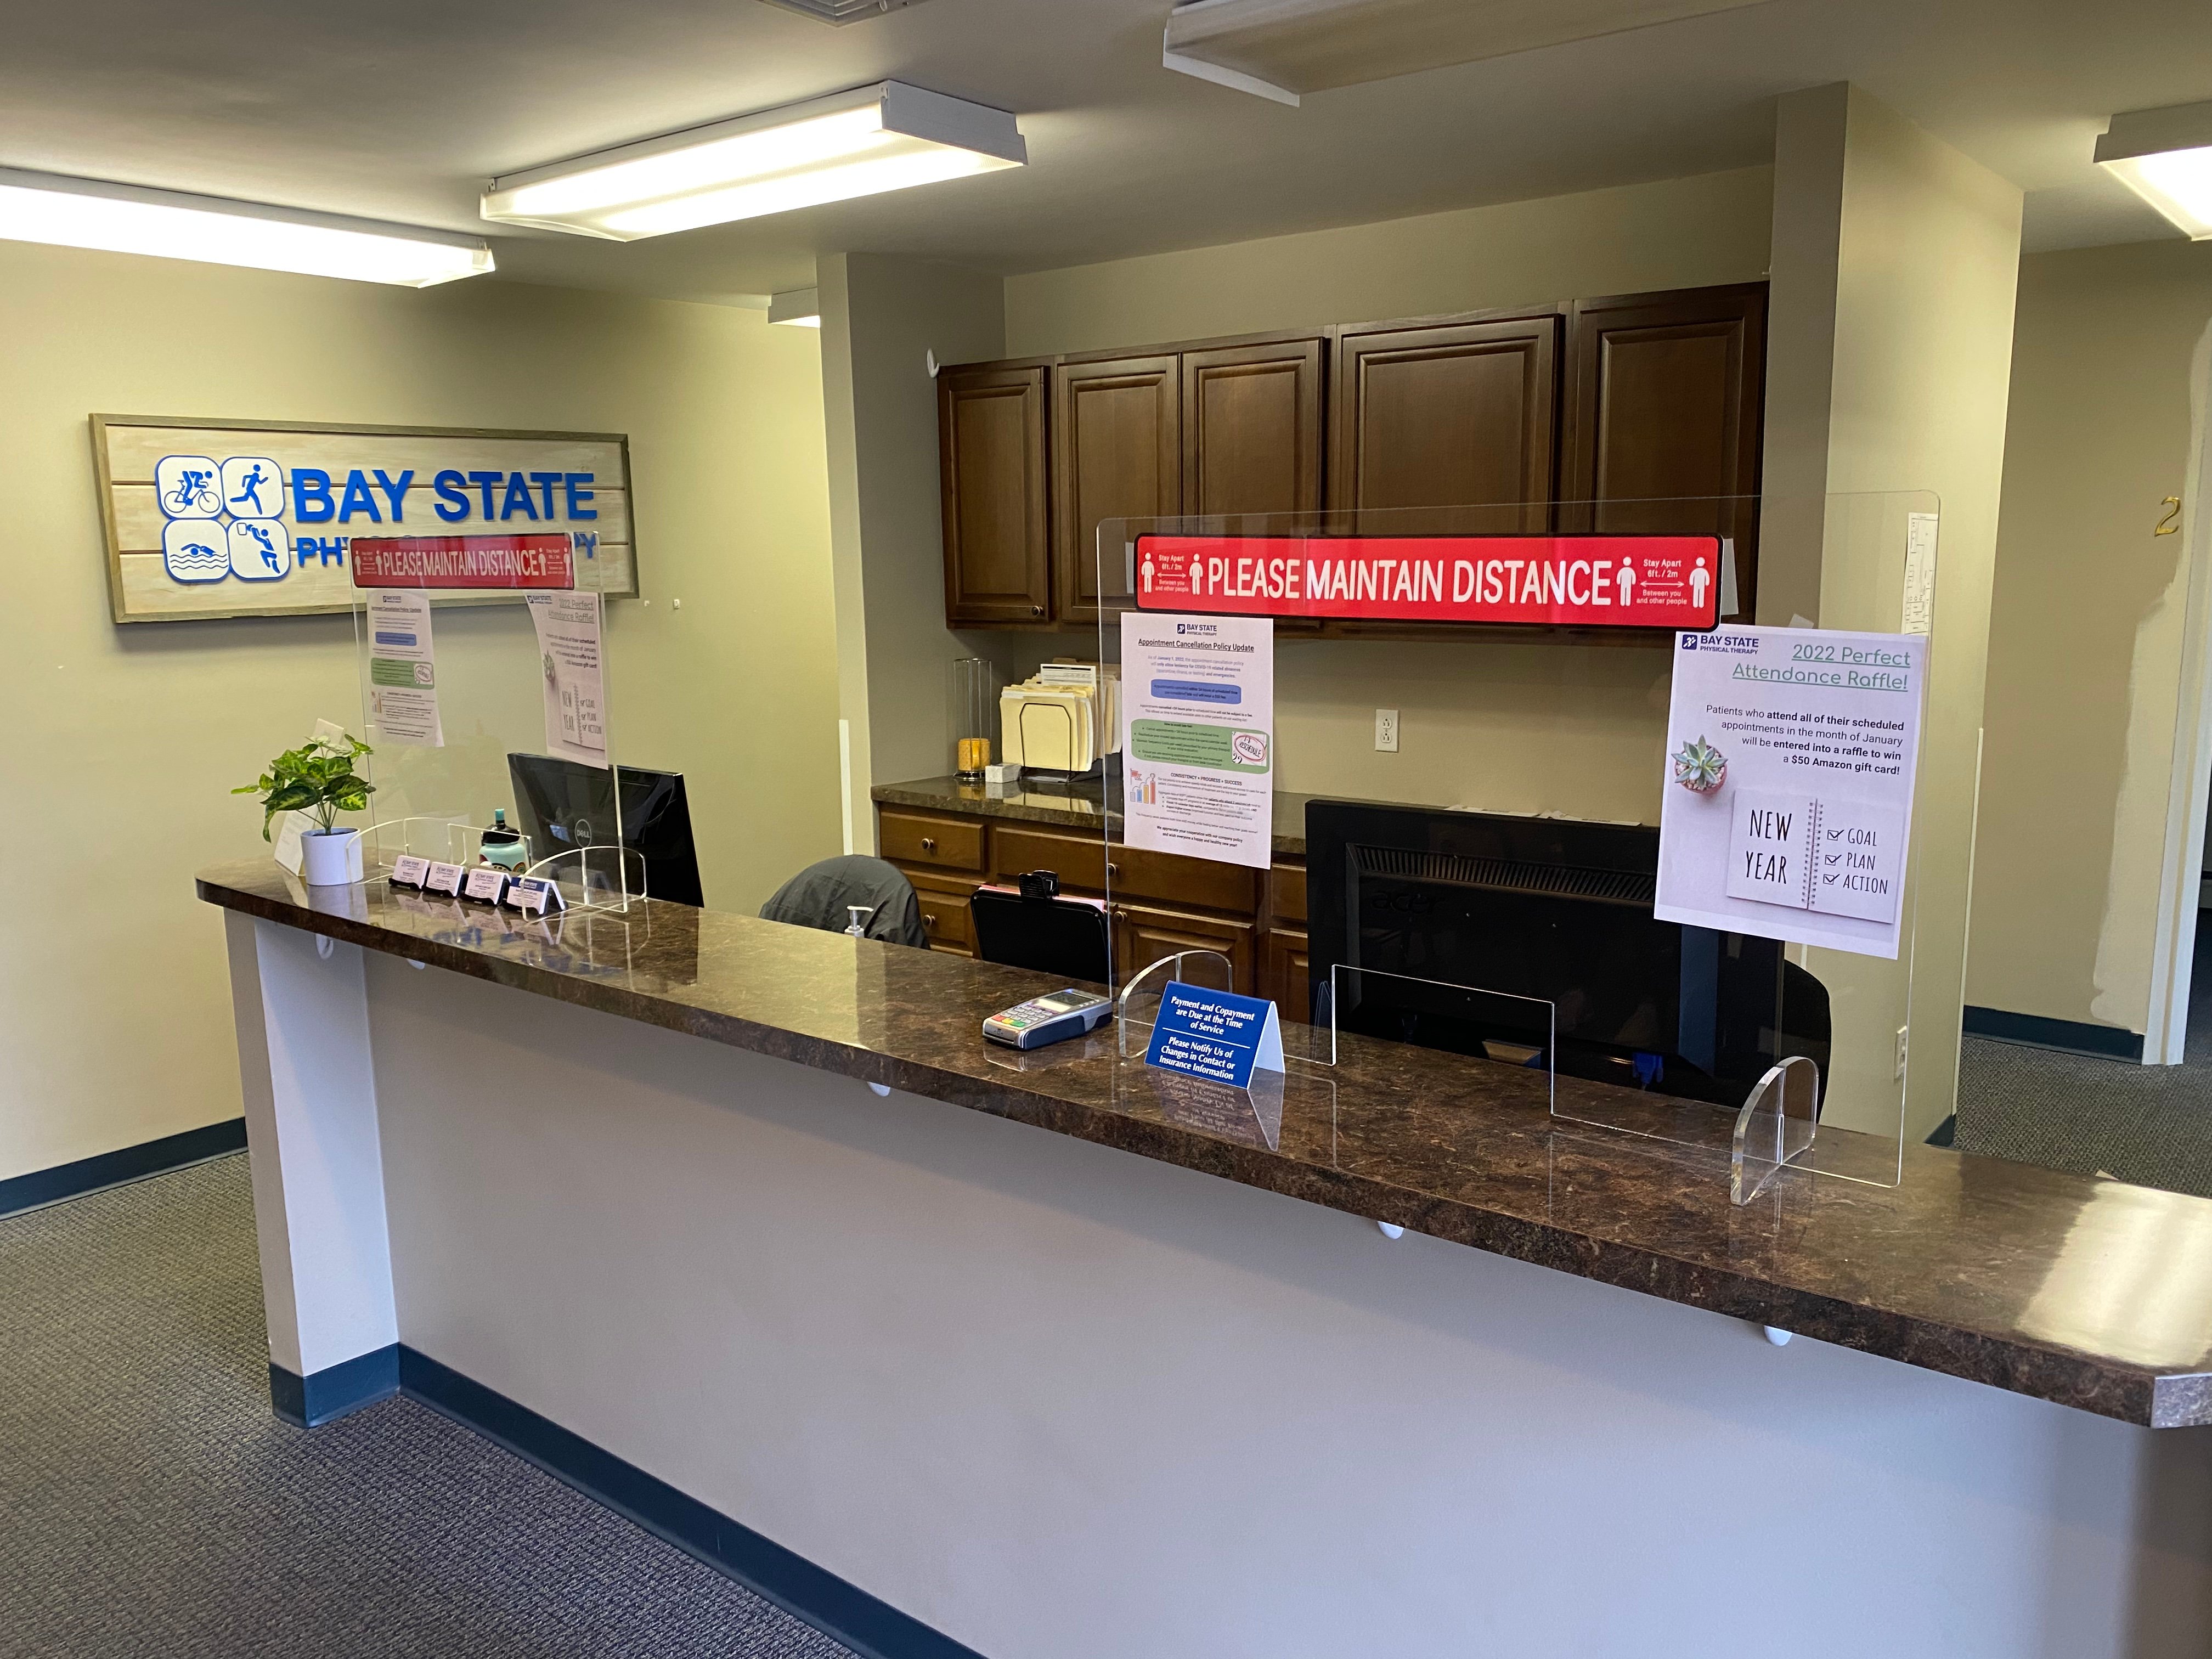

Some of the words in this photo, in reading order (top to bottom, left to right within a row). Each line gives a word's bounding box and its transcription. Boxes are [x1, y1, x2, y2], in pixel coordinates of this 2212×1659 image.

[291, 468, 414, 523] BAY
[433, 470, 597, 522] STATE
[2154, 496, 2181, 537] 2
[383, 551, 422, 576] PLEASE
[422, 550, 477, 576] MAINTAIN
[478, 550, 539, 576] DISTANCE
[1159, 554, 1170, 562] Stay
[1170, 555, 1184, 563] Apart
[1643, 558, 1660, 568] Stay
[1661, 558, 1681, 568] Apart
[1208, 557, 1300, 599] PLEASE
[1306, 560, 1443, 602] MAINTAIN
[1453, 560, 1612, 606] DISTANCE
[1647, 569, 1661, 578] 6ft.
[572, 599, 593, 609] Perfect
[1666, 597, 1687, 606] people
[575, 612, 594, 622] Raffle!
[1176, 641, 1212, 649] Cancellation
[1214, 643, 1231, 651] Policy
[1700, 635, 1723, 646] BAY
[1724, 636, 1759, 648] STATE
[1793, 644, 1835, 661] 2022
[1842, 647, 1910, 665] Perfect
[1733, 663, 1841, 684] Attendance
[1848, 670, 1908, 689] Raffle!
[1706, 704, 1743, 716] Patients
[1745, 709, 1764, 718] who
[1767, 712, 1798, 721] attend
[1800, 713, 1812, 722] all
[1814, 715, 1825, 723] of
[1827, 715, 1850, 725] their
[1852, 719, 1904, 730] scheduled
[1722, 721, 1784, 734] appointments
[1787, 726, 1795, 735] in
[1798, 727, 1813, 737] the
[1816, 731, 1847, 740] month
[1850, 732, 1860, 741] of
[1863, 733, 1903, 747] January
[1742, 737, 1757, 745] will
[1759, 737, 1771, 747] be
[1774, 741, 1810, 751] entered
[1813, 743, 1831, 753] into
[1842, 747, 1868, 757] raffle
[1871, 750, 1881, 758] to
[1884, 751, 1901, 760] win
[1791, 754, 1809, 765] $50
[1812, 758, 1852, 770] Amazon
[1855, 762, 1872, 772] gift
[1874, 766, 1900, 775] card!
[1750, 809, 1792, 842] NEW
[1848, 828, 1877, 847] GOAL
[1746, 850, 1787, 884] YEAR
[1847, 852, 1876, 871] PLAN
[1843, 874, 1888, 895] ACTION
[1171, 996, 1200, 1009] Payment
[1200, 1003, 1215, 1012] and
[1215, 1006, 1255, 1021] Copayment
[1176, 1008, 1188, 1017] are
[1188, 1009, 1203, 1020] Due
[1203, 1014, 1212, 1022] at
[1212, 1015, 1224, 1025] the
[1226, 1017, 1243, 1029] Time
[1190, 1020, 1200, 1029] of
[1198, 1022, 1224, 1035] Service
[1161, 1045, 1189, 1059] Changes
[1189, 1051, 1197, 1060] in
[1198, 1054, 1226, 1068] Contact
[1168, 1036, 1190, 1048] Please
[1190, 1041, 1213, 1056] Notify
[1214, 1047, 1224, 1057] Us
[1224, 1049, 1234, 1059] of
[1159, 1054, 1192, 1070] Insurance
[1192, 1063, 1234, 1080] Information
